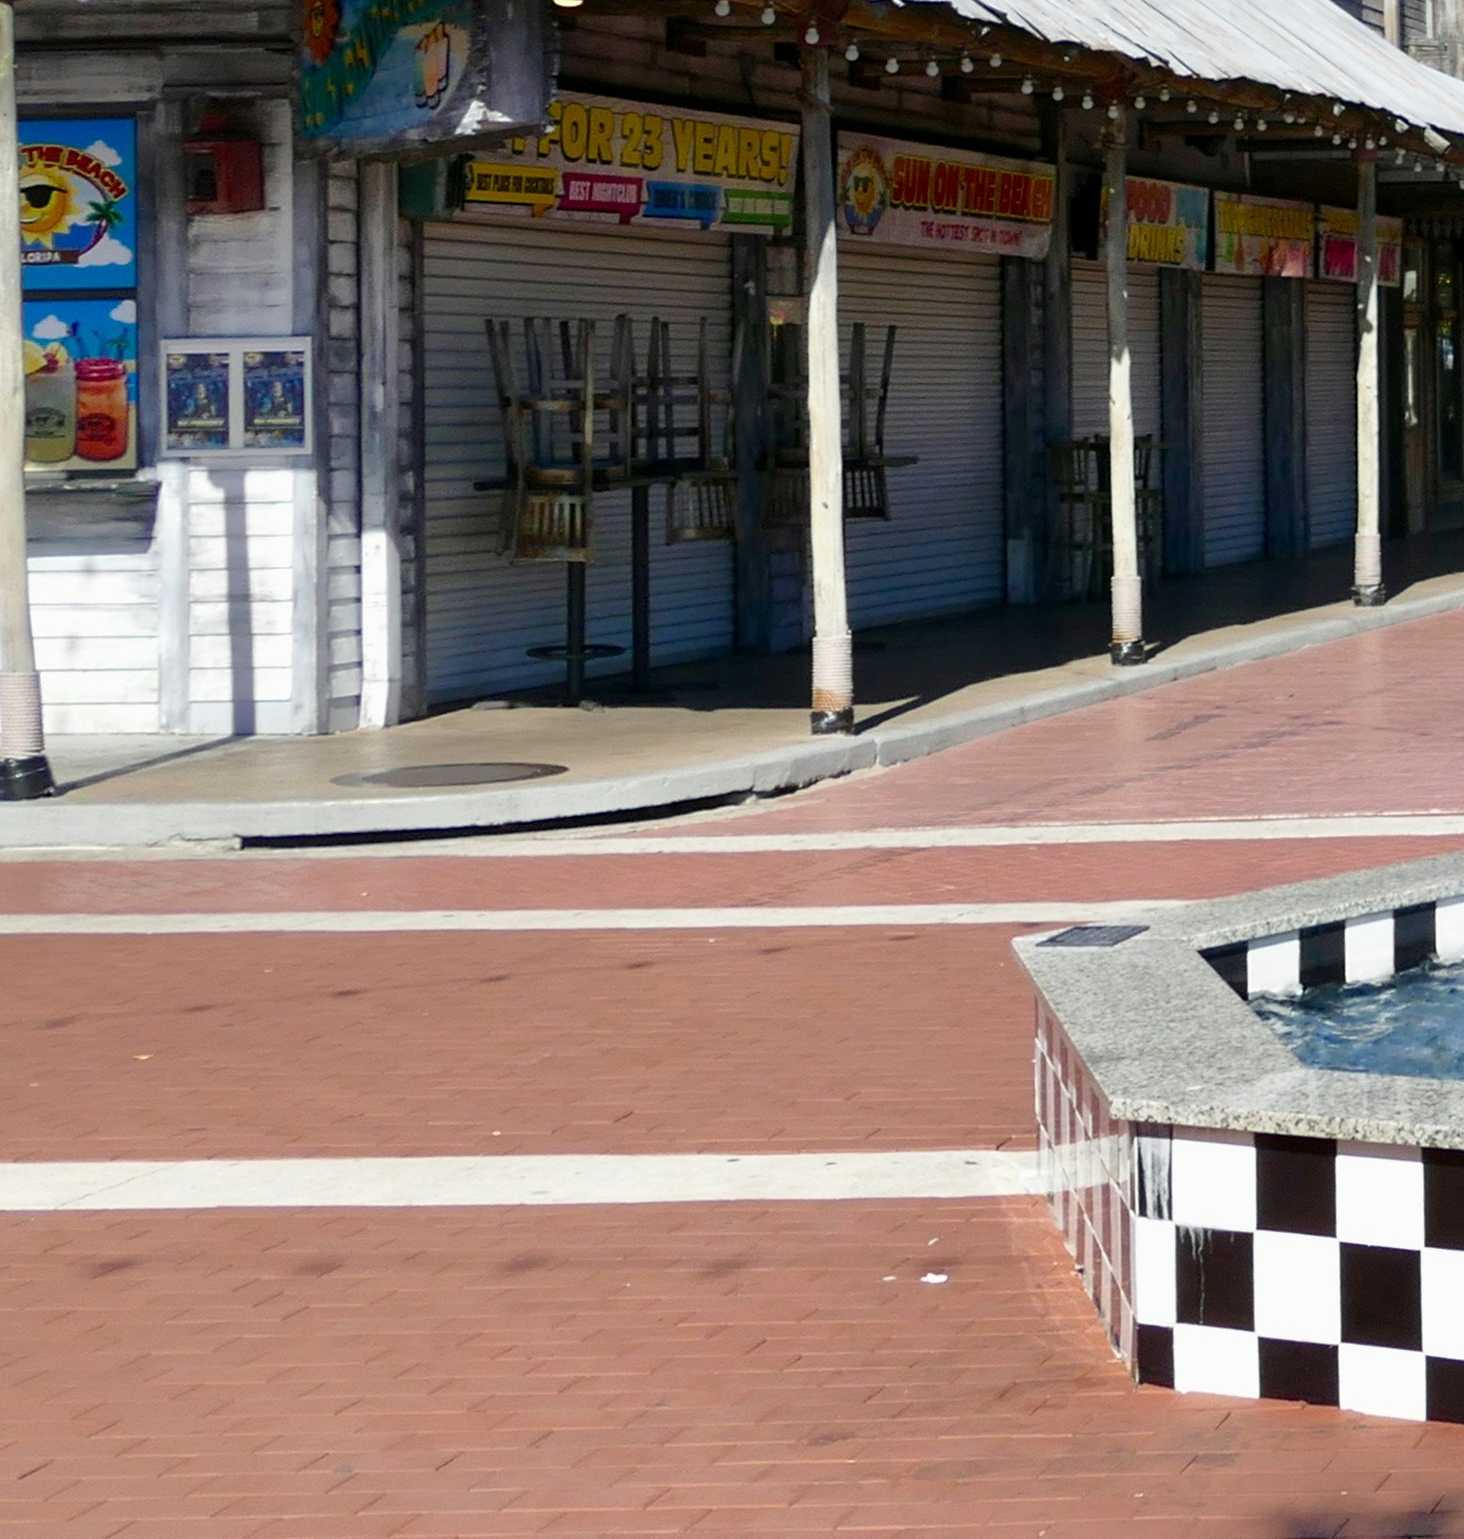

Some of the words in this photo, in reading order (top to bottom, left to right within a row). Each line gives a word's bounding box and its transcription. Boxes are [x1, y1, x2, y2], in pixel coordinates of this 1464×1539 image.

[620, 110, 664, 169] 23
[672, 116, 793, 186] YEARS!
[569, 180, 591, 201] BEST
[890, 154, 931, 205] SUN
[933, 162, 960, 211] ON
[962, 167, 996, 215] THE
[19, 250, 62, 263] LORIDA
